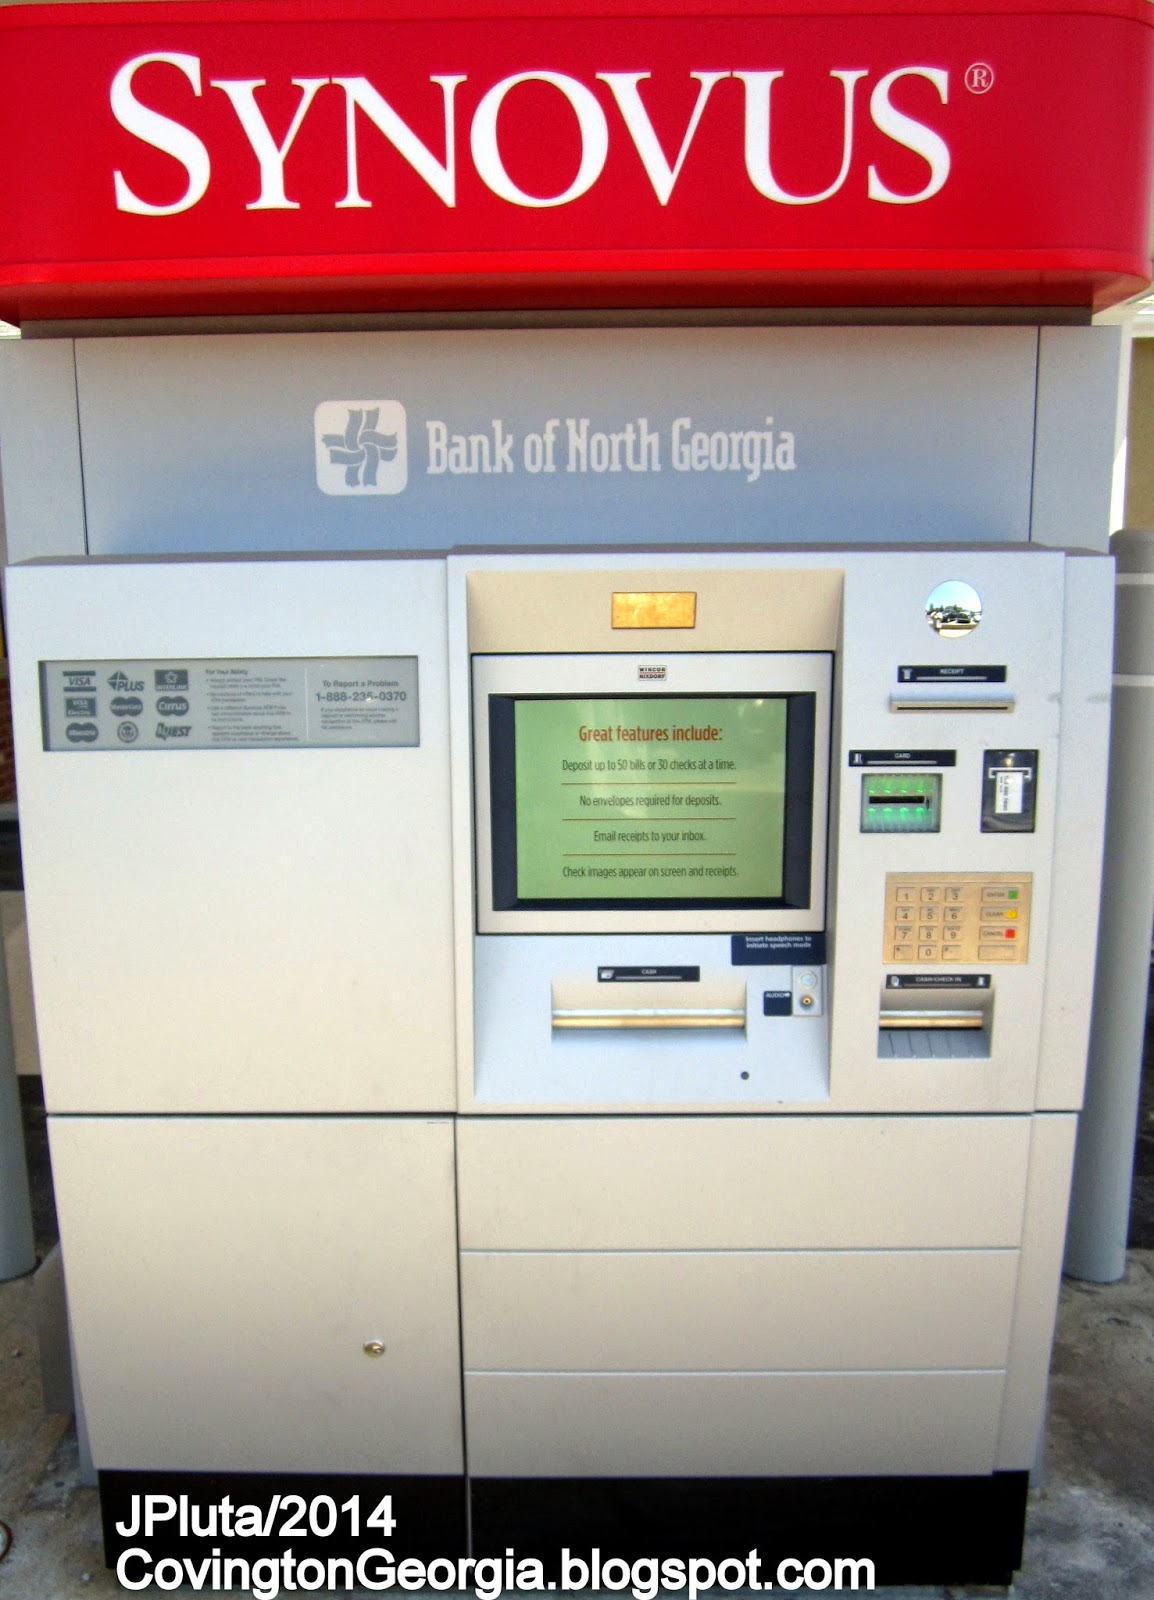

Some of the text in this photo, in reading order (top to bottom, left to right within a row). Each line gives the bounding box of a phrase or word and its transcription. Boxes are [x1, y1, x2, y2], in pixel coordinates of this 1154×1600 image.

[109, 52, 951, 216] SYNOVUS
[425, 416, 797, 483] Bank of North Georgia
[69, 677, 91, 686] VISA
[117, 680, 145, 692] PLUS
[333, 680, 358, 688] Report
[315, 691, 407, 702] 1-888-235-0370
[158, 701, 187, 711] Cirrus
[155, 722, 192, 741] QUEST
[578, 725, 723, 742] Great features include:
[562, 759, 592, 772] Deposit
[594, 761, 605, 772] up
[607, 760, 616, 770] to
[617, 759, 628, 771] 50
[629, 759, 646, 770] bills
[647, 761, 656, 770] or
[658, 759, 668, 770] 30
[669, 759, 697, 770] checks
[698, 759, 706, 770] at
[715, 758, 737, 770] time.
[579, 794, 722, 807] No envelopes required for deposits.
[593, 829, 707, 843] Email receipts to your inbox.
[562, 864, 739, 878] Check images appear on screen and receipts.
[951, 912, 958, 920] 6
[950, 931, 957, 940] 9
[925, 948, 932, 957] 0
